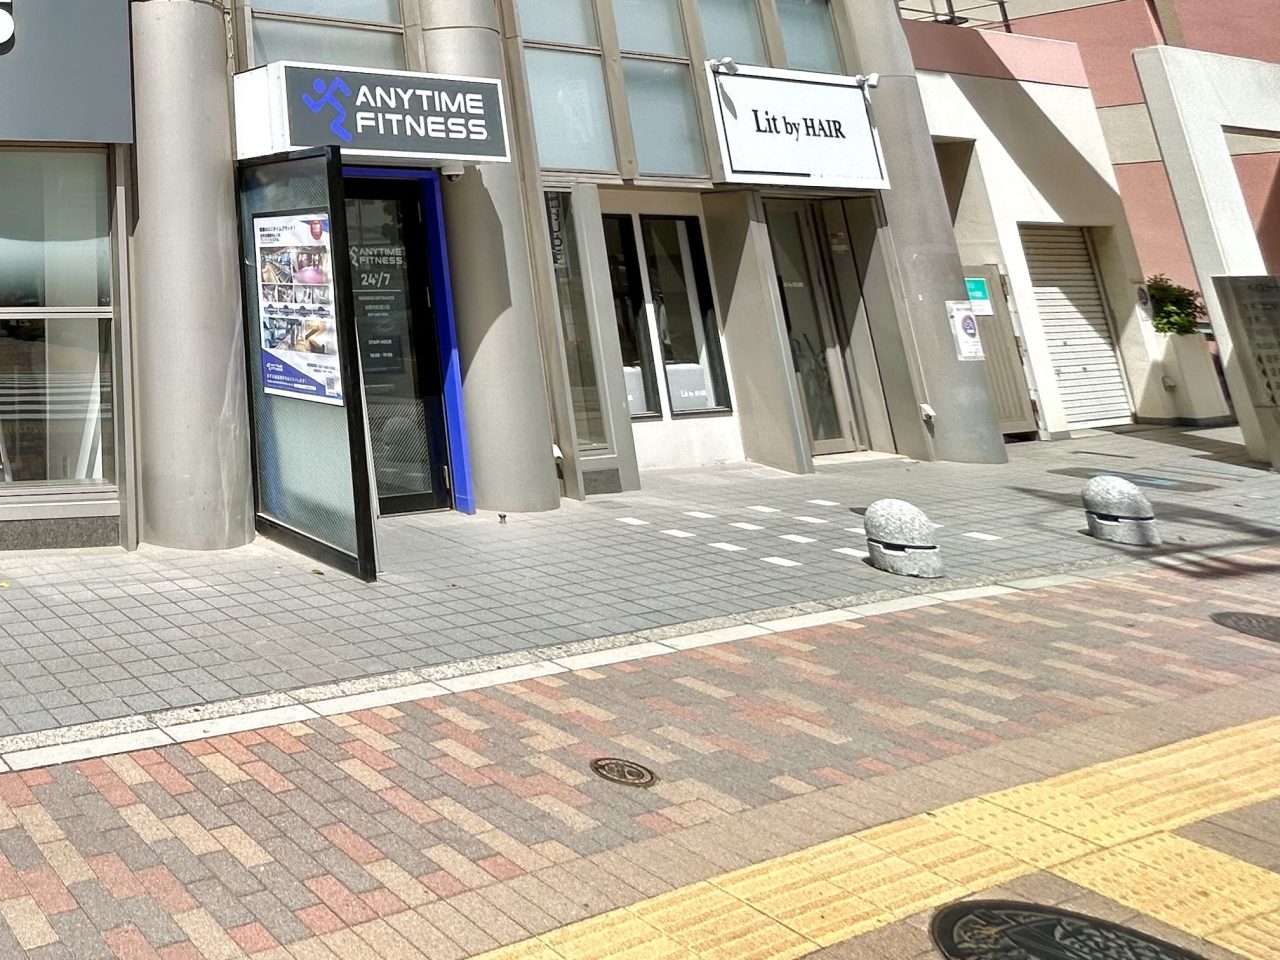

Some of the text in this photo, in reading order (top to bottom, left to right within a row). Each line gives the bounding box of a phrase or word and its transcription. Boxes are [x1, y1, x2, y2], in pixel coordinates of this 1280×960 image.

[355, 85, 484, 114] ANYTIME
[356, 111, 488, 140] FITNESS
[751, 109, 846, 142] Lit by HAIR
[359, 247, 403, 256] ANYTIME
[359, 256, 403, 265] FITNESS
